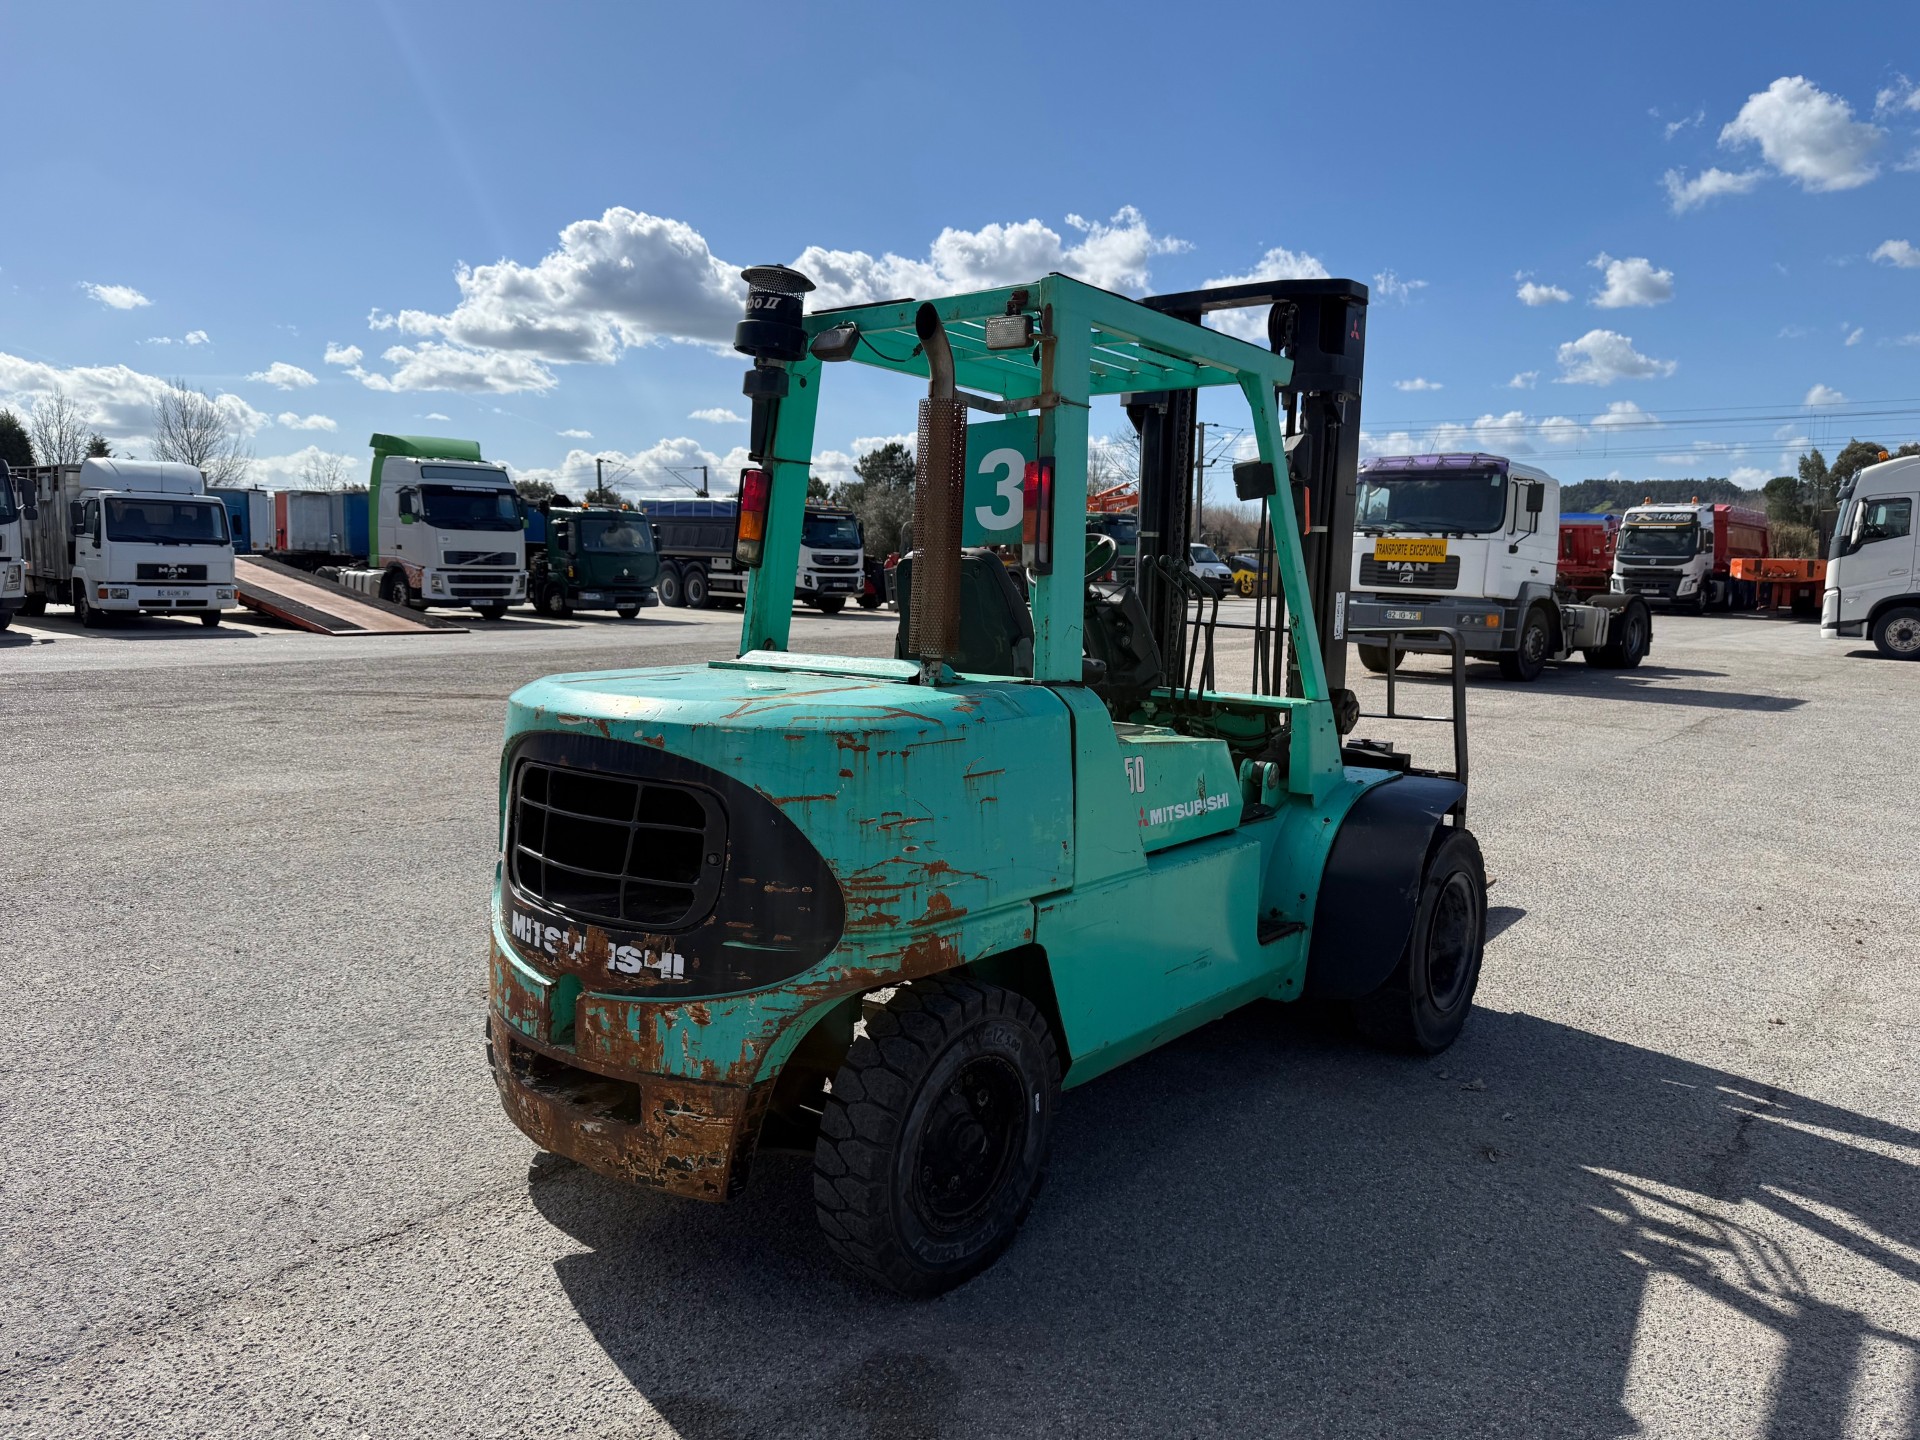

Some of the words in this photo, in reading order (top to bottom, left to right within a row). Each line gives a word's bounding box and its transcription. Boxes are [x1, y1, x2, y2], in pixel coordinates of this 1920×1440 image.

[975, 447, 1026, 531] 3
[1376, 543, 1408, 556] TRANSPORTE
[1409, 544, 1445, 558] EXCEPCIONAL
[1386, 562, 1429, 572] MAN
[1124, 755, 1145, 794] 50
[1149, 792, 1230, 826] MITSUBISHI
